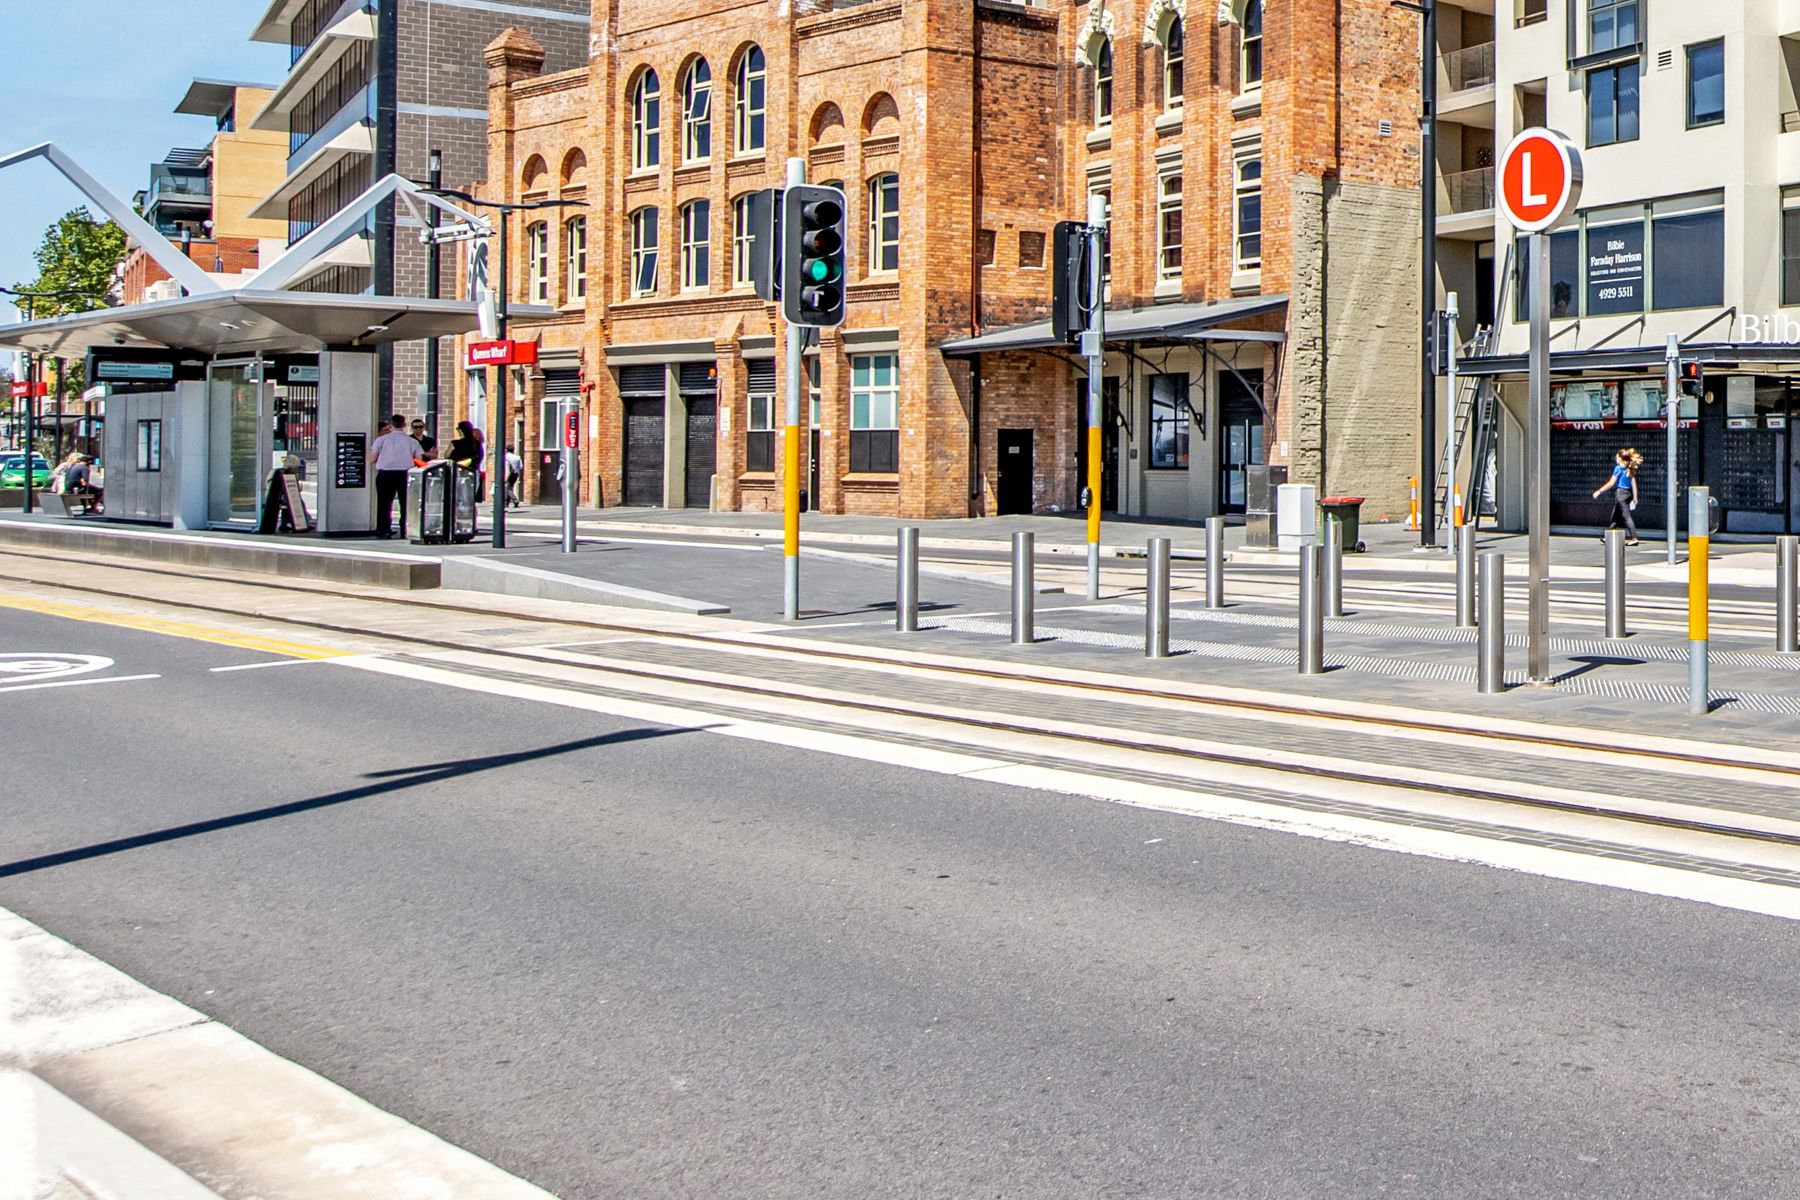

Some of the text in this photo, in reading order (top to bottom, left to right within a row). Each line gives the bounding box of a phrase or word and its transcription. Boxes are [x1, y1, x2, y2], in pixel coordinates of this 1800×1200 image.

[1522, 151, 1547, 207] L
[1607, 240, 1625, 251] Bilbie
[1599, 286, 1633, 300] 4929 5511
